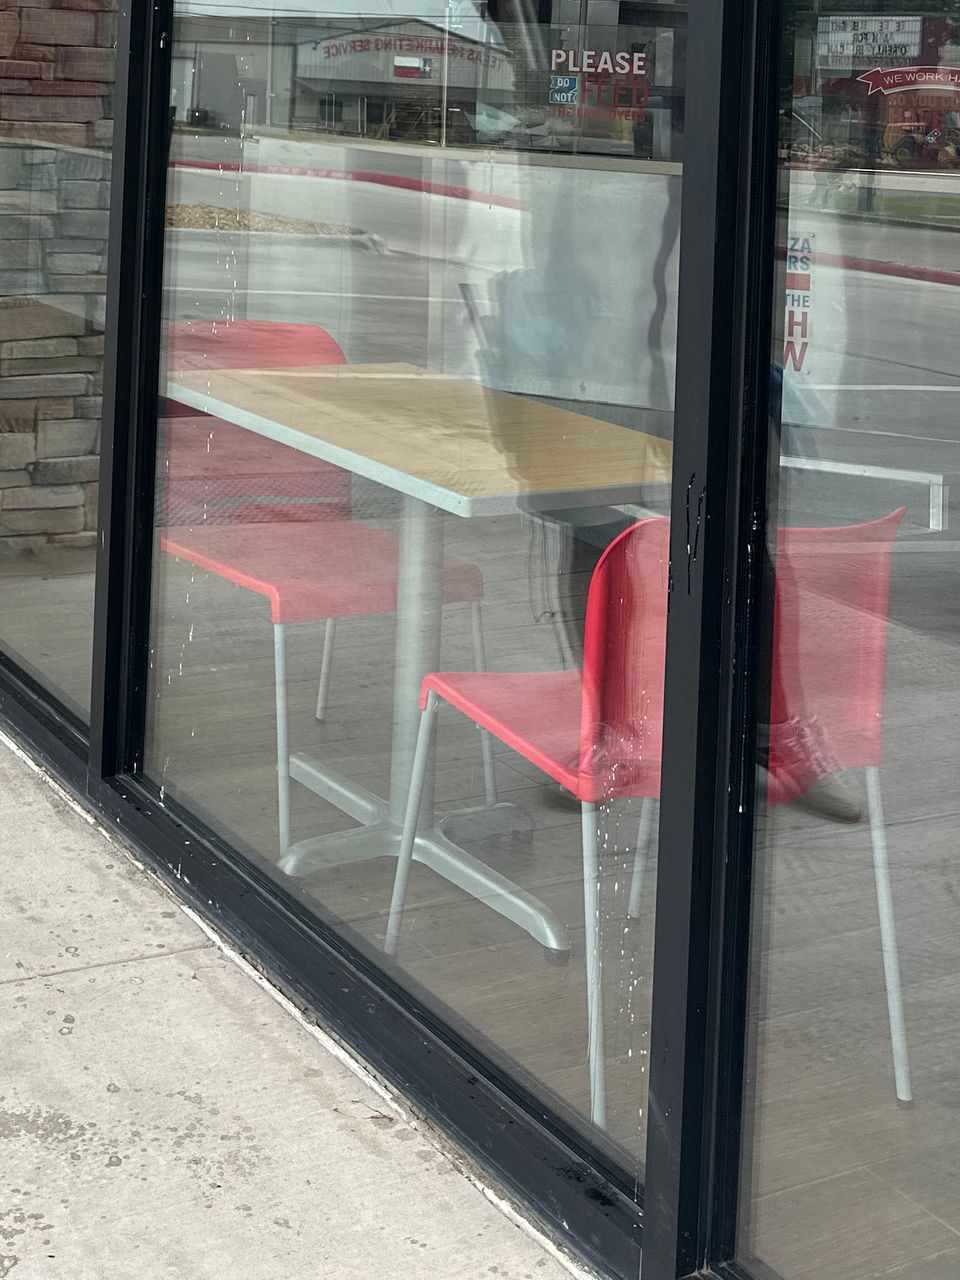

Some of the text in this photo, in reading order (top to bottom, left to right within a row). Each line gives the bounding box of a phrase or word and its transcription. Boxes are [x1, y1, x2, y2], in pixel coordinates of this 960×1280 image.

[551, 49, 646, 75] PLEASE
[557, 78, 570, 88] DO
[883, 72, 960, 85] WE WORK H
[554, 92, 573, 102] NOT
[581, 78, 649, 108] FEED
